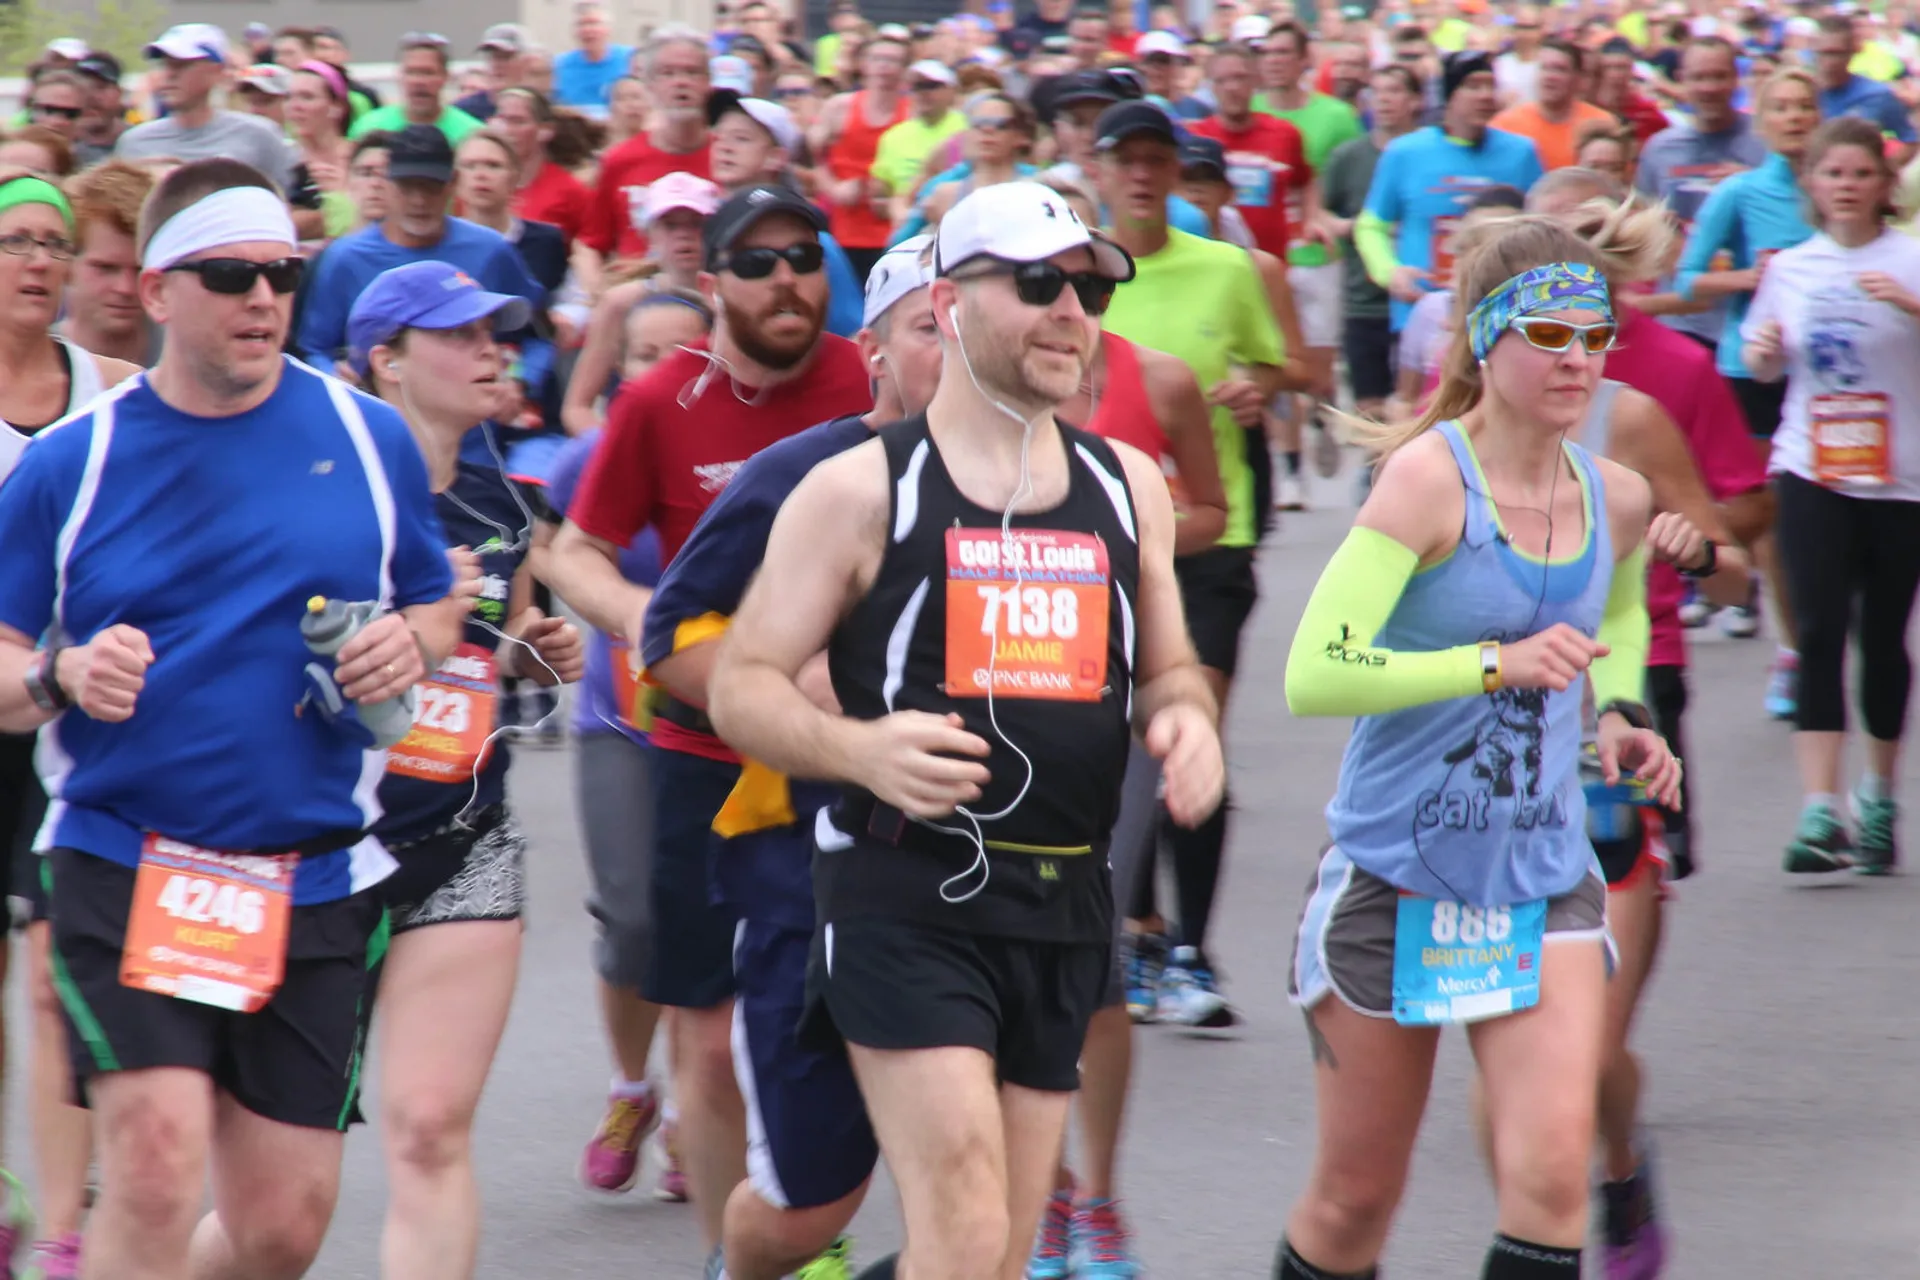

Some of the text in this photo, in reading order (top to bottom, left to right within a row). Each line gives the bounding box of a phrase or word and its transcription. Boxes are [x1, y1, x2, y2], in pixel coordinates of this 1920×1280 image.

[958, 540, 1001, 568] GO!
[1031, 543, 1096, 572] Louis
[950, 566, 1107, 585] HALF MARATHON
[977, 585, 1078, 639] 7138
[994, 640, 1064, 664] JAMIE
[993, 670, 1072, 690] PNC BANK
[1417, 788, 1490, 832] cat
[156, 874, 267, 934] 4246
[1422, 943, 1515, 966] BRITTANY
[1517, 952, 1534, 971] E
[1437, 975, 1488, 994] Mercy
